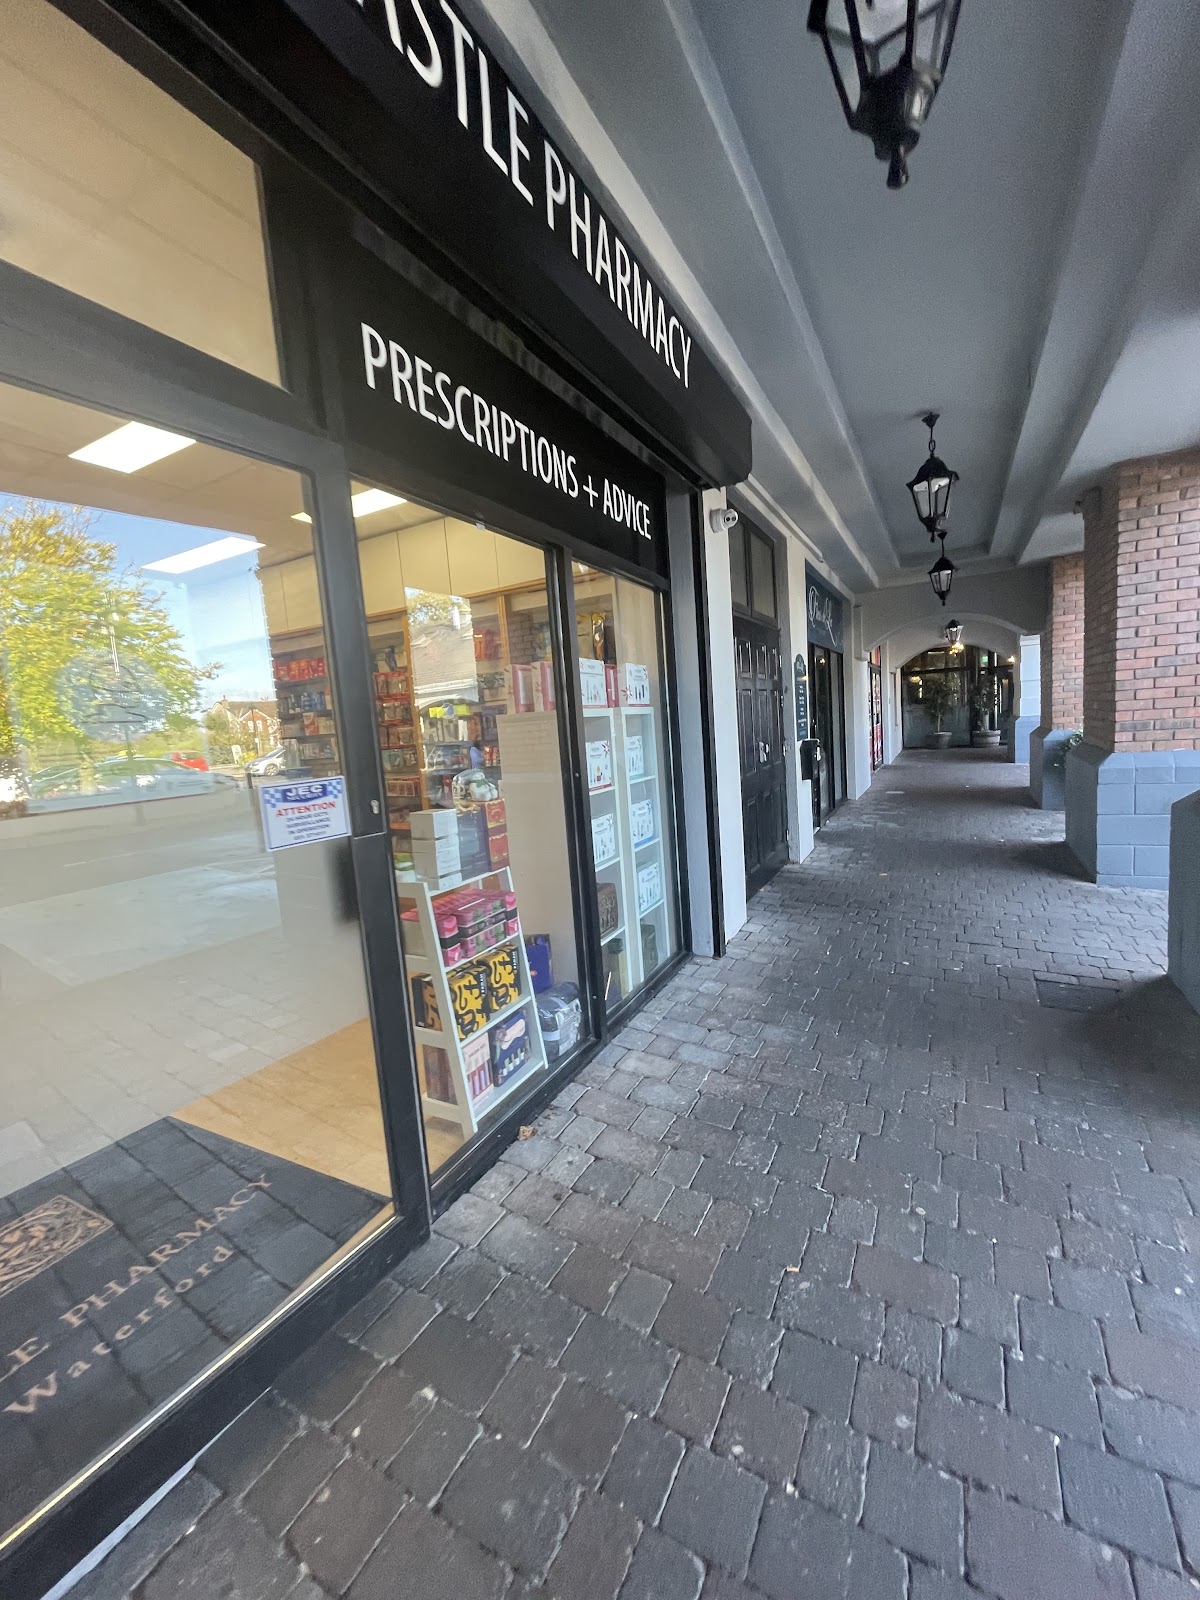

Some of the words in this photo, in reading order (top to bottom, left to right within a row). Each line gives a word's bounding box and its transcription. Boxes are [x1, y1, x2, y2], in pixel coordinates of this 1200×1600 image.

[357, 0, 533, 206] STLE
[545, 139, 692, 388] PHARMACY
[361, 322, 578, 499] PRESCRIPTIONS
[583, 475, 599, 508] +
[603, 477, 652, 540] ADVICE
[277, 801, 336, 816] ATTENTION
[286, 785, 323, 797] JEC
[2, 1245, 234, 1413] Waterford
[60, 1173, 272, 1328] PHARMACY
